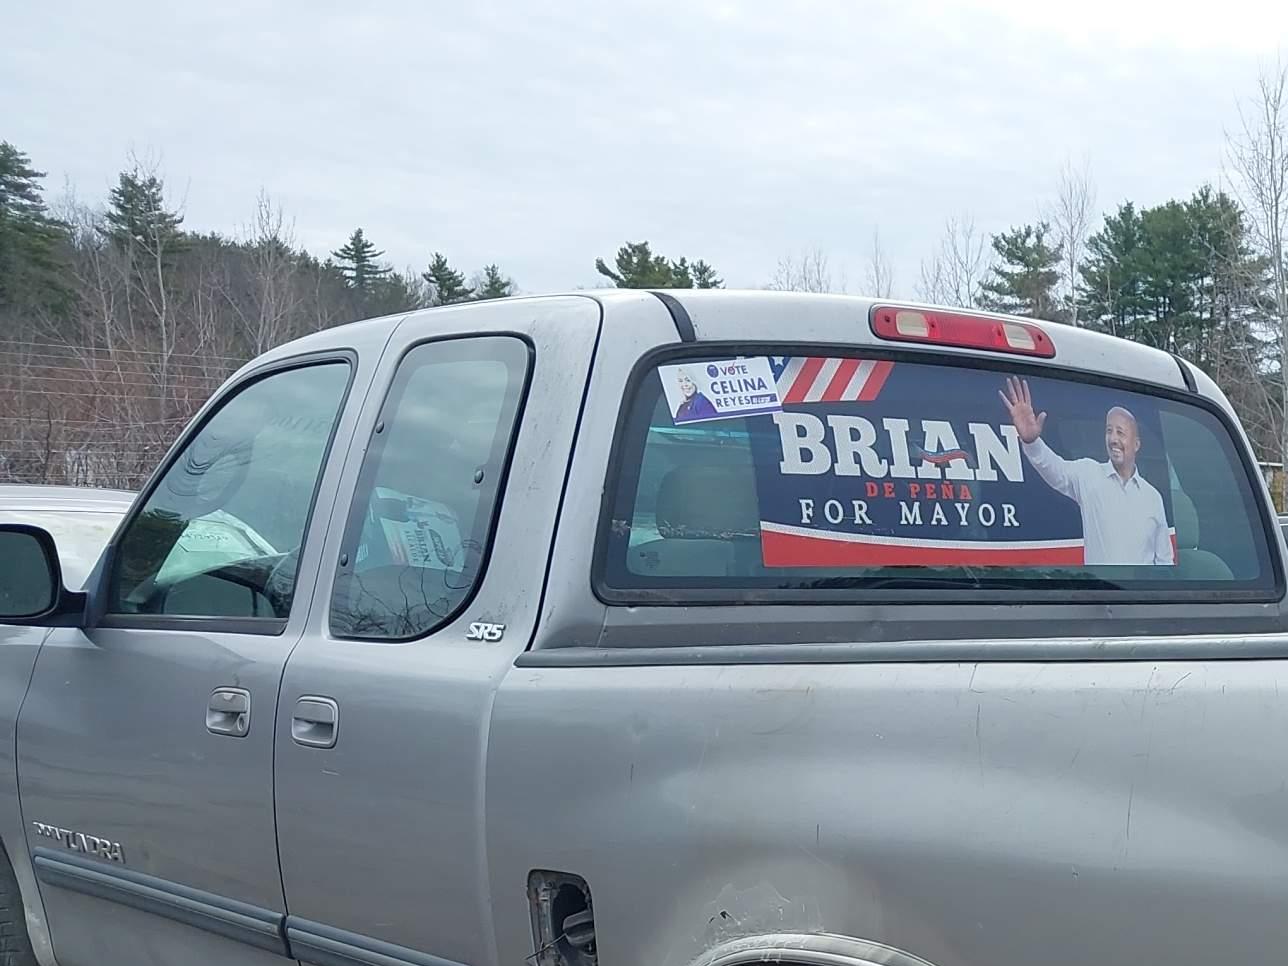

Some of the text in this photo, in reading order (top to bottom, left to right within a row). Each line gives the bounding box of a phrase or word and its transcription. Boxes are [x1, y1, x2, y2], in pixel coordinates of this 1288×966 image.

[720, 362, 748, 376] VOTE
[711, 376, 769, 395] CELINA
[715, 395, 751, 408] REYES
[773, 411, 1024, 483] BRIAN
[865, 480, 974, 500] DE PEÑA
[799, 499, 1020, 528] FOR MAYOR
[466, 622, 506, 642] SR5
